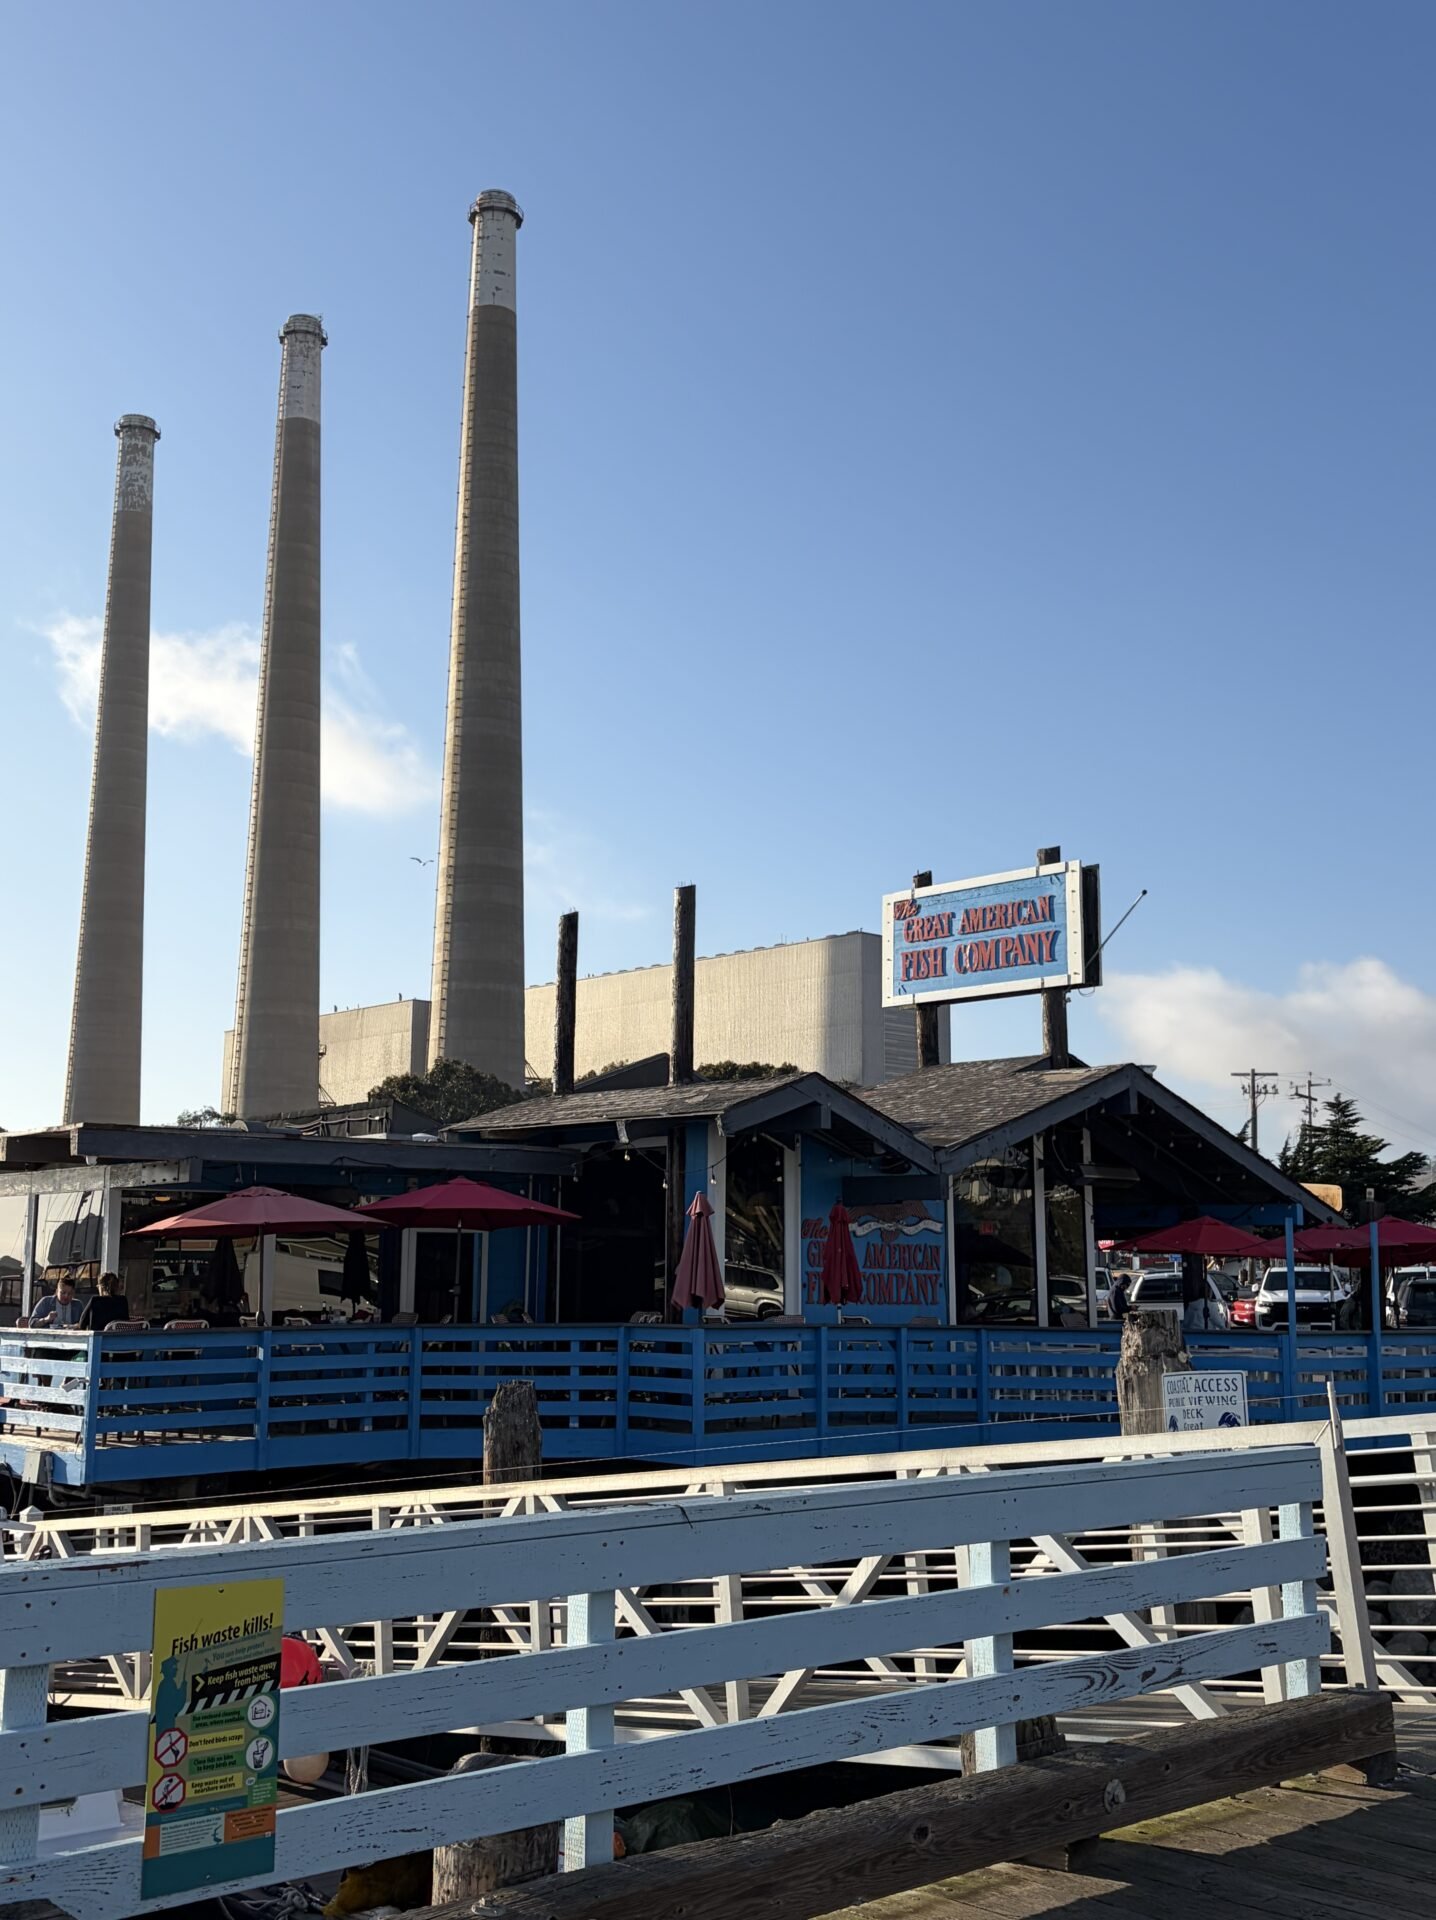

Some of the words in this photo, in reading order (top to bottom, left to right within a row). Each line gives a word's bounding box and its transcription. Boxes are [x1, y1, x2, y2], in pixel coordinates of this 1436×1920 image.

[894, 900, 922, 920] The
[903, 911, 956, 944] GREAT
[958, 894, 1056, 935] AMERICAN
[900, 946, 948, 982] FISH
[954, 930, 1061, 974] COMPANY
[801, 1218, 829, 1240] The
[862, 1242, 942, 1270] AMERICAN
[1166, 1378, 1190, 1394] COASTAL
[1194, 1378, 1238, 1392] ACCESS
[1182, 1408, 1204, 1419] DECK
[172, 1634, 198, 1656] Fish
[201, 1625, 240, 1648] waste
[243, 1612, 273, 1636] kills!
[213, 1651, 225, 1661] You
[208, 1676, 224, 1686] Keep
[225, 1670, 238, 1680] fish
[239, 1666, 258, 1677] waste
[259, 1662, 277, 1673] away
[234, 1678, 250, 1688] from
[252, 1672, 270, 1683] birds.
[189, 1740, 202, 1748] Don't
[203, 1737, 214, 1745] feed
[194, 1786, 218, 1794] nearshore
